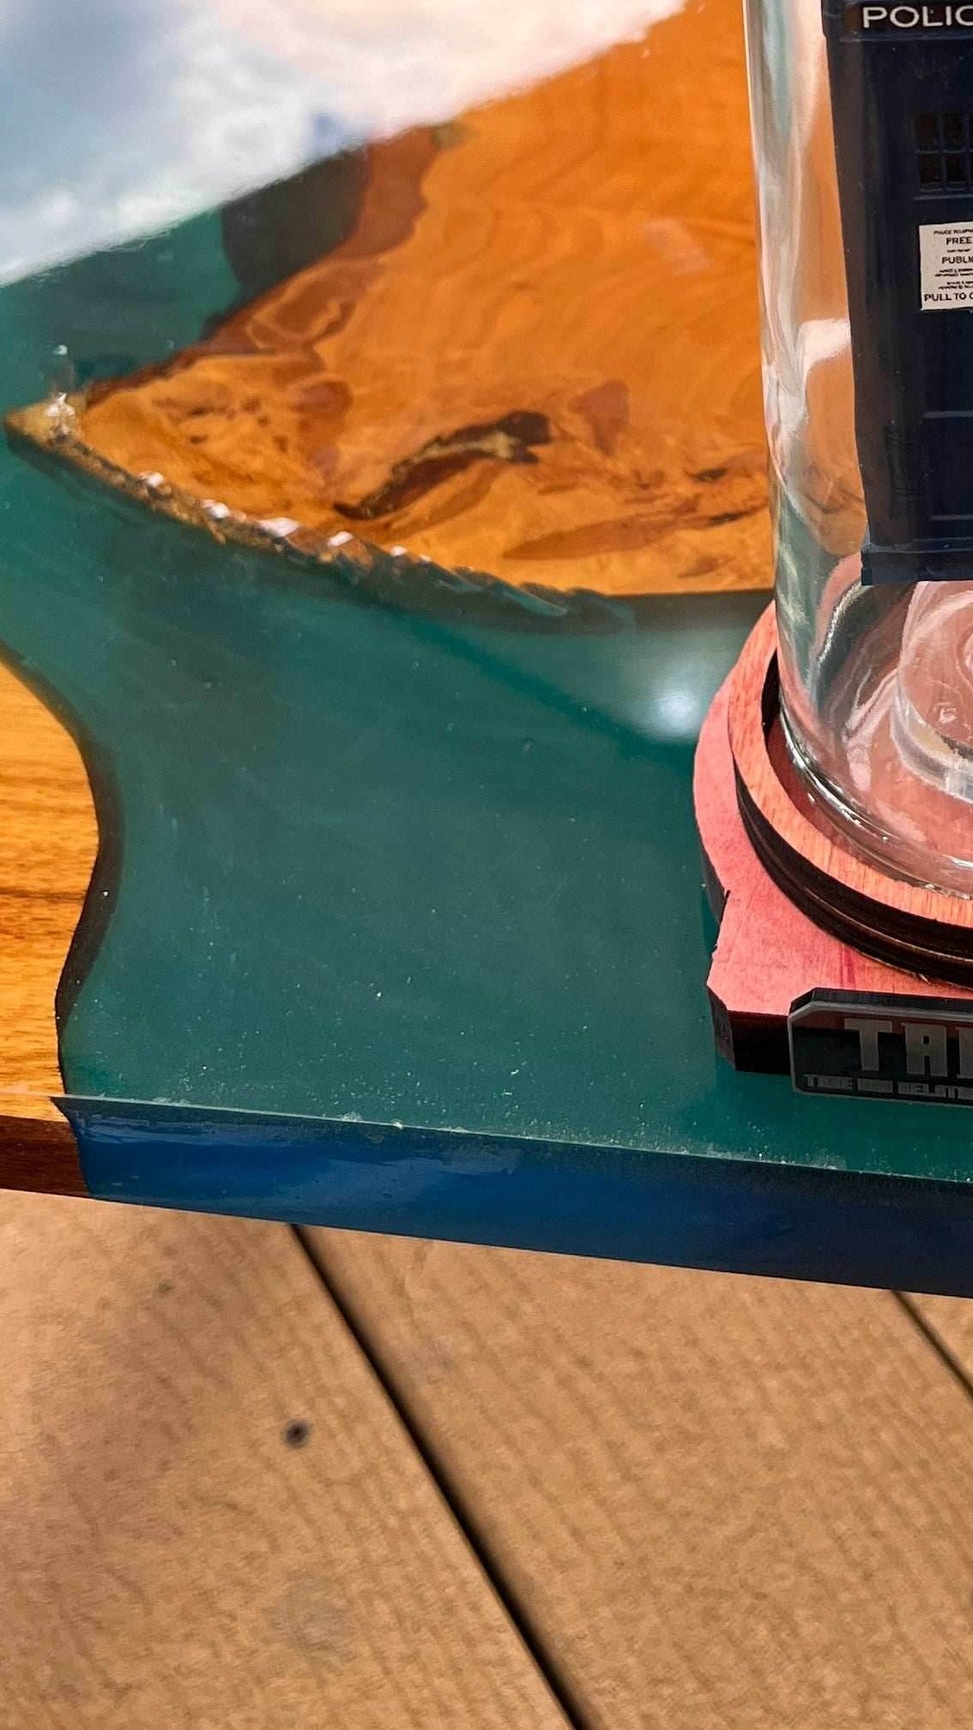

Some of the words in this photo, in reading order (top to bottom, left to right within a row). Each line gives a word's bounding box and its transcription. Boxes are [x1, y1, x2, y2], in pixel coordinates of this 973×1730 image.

[946, 236, 972, 245] FREE
[924, 293, 952, 301] PULL
[954, 292, 967, 300] TO
